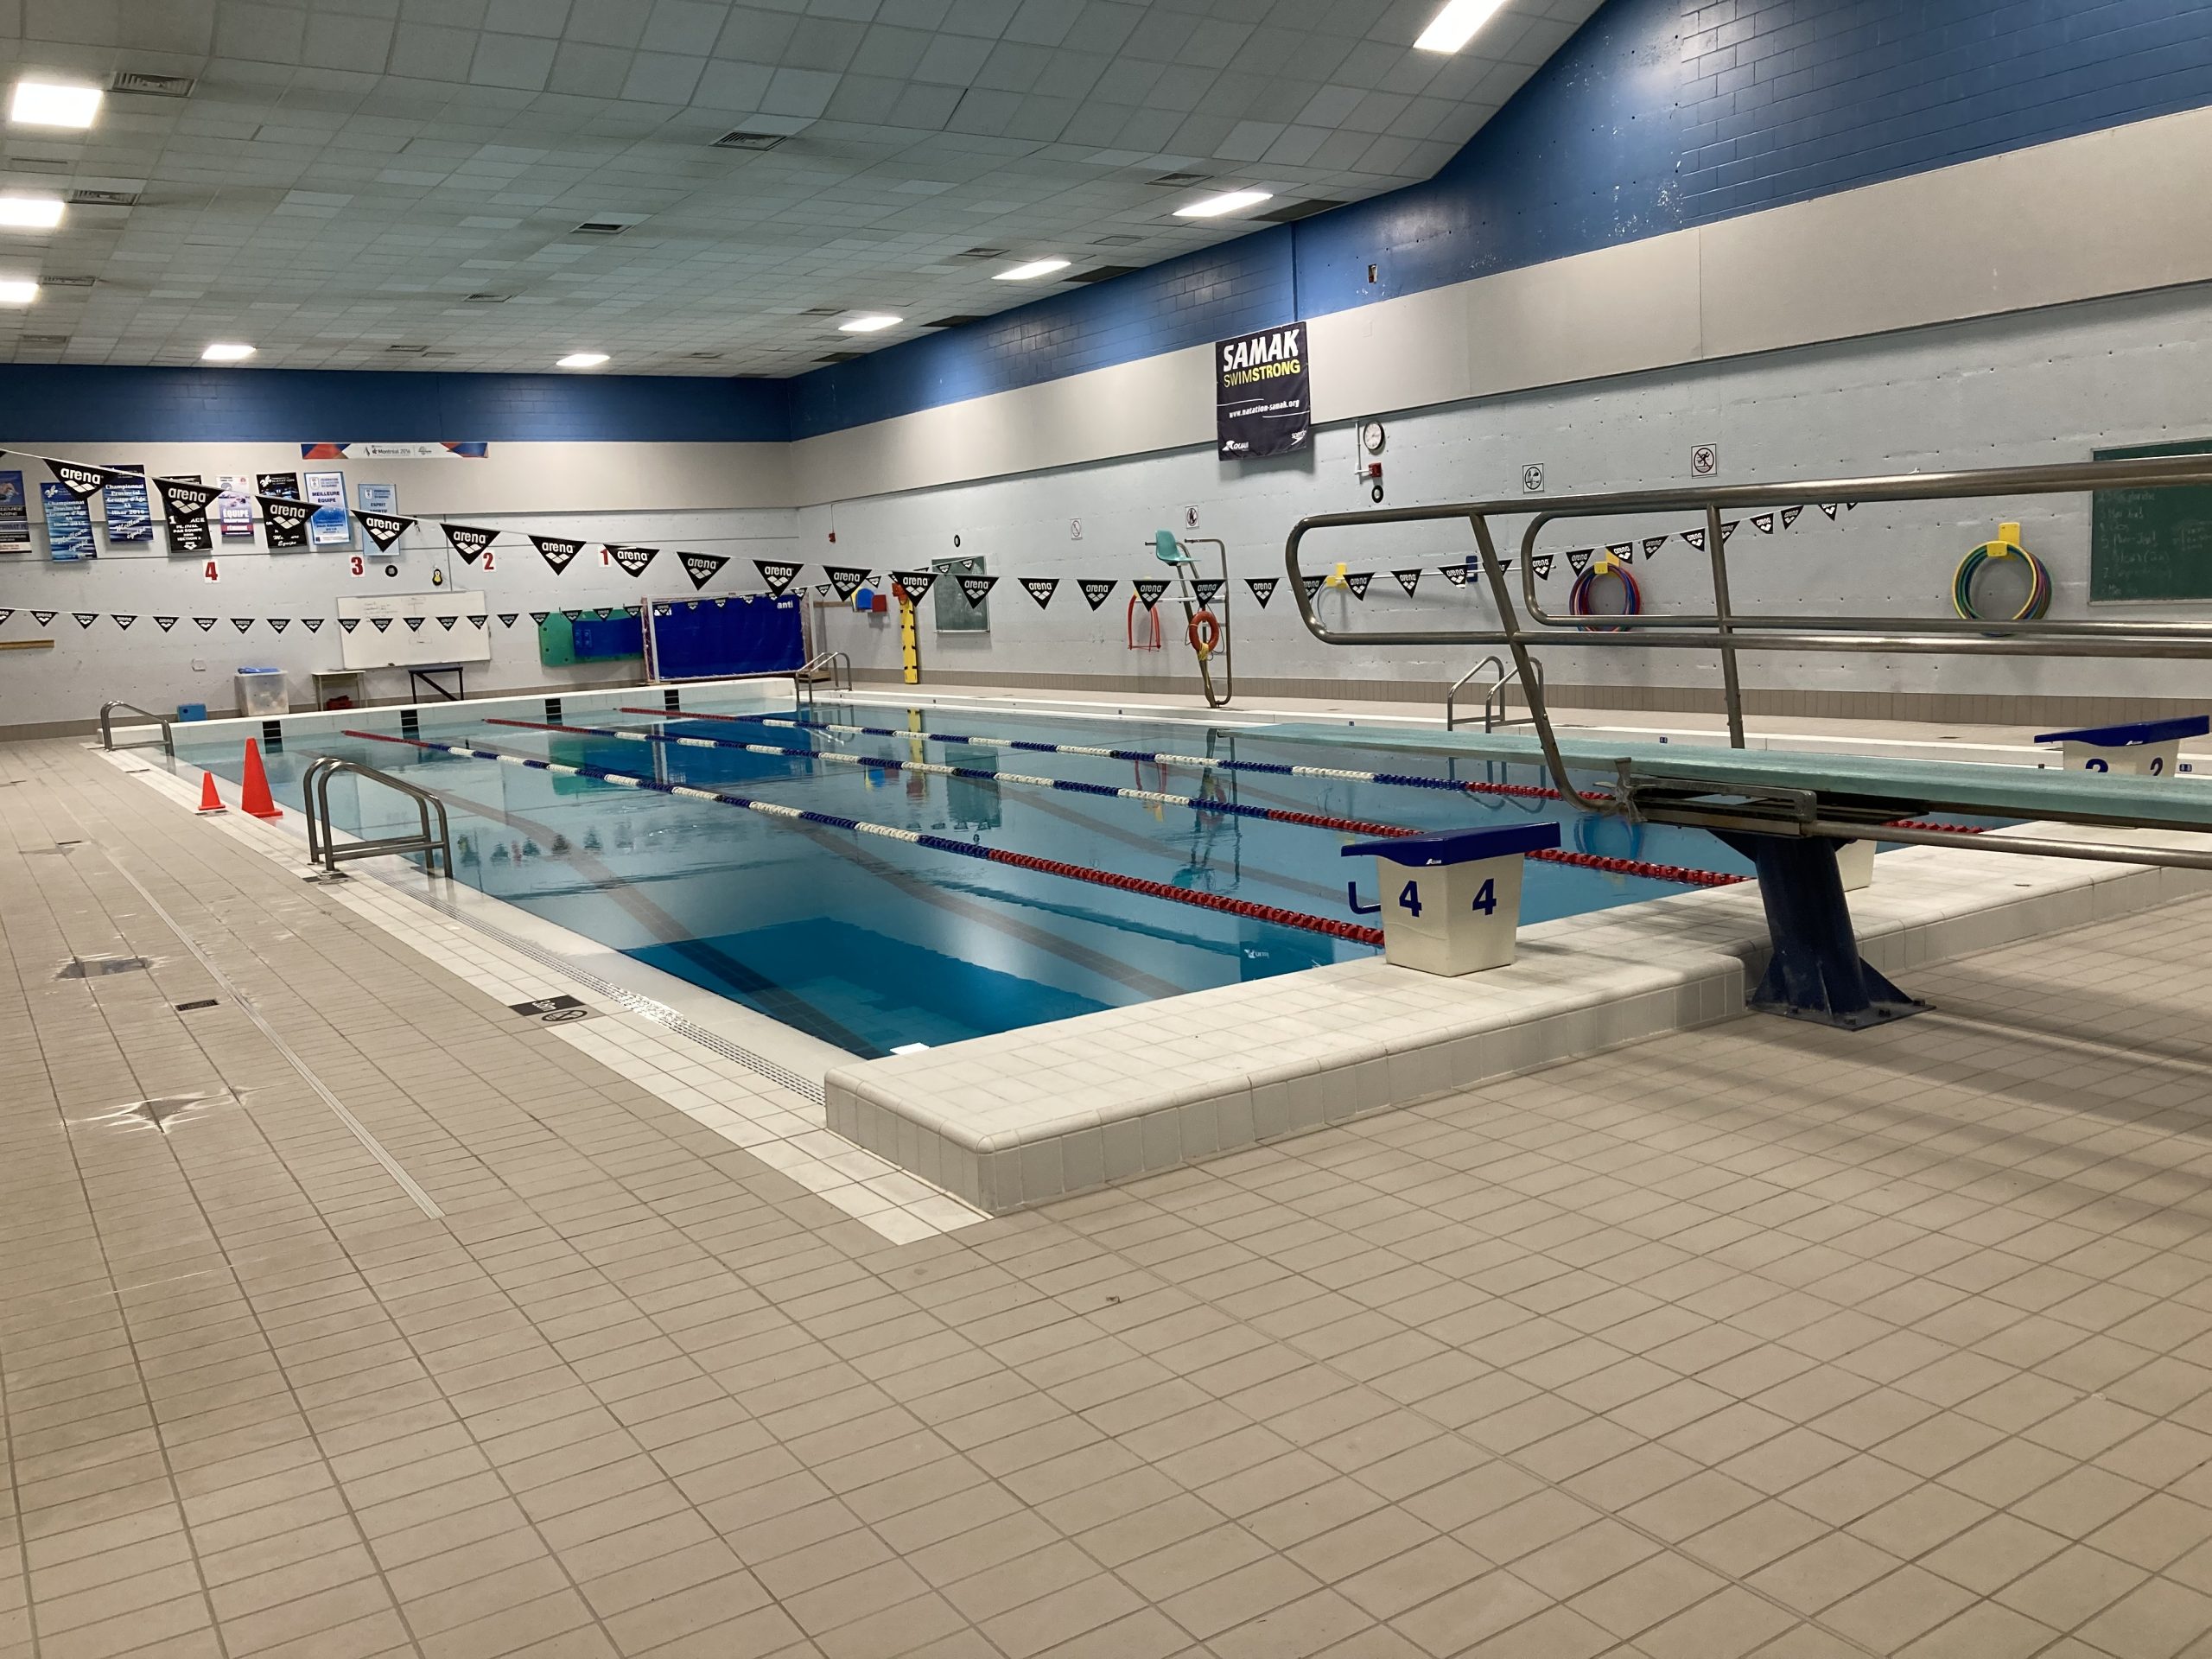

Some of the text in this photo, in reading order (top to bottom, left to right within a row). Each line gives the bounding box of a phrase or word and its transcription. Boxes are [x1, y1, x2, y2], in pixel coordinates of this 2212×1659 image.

[1224, 329, 1300, 372] SAMAK
[1224, 359, 1300, 388] SWIMSTRONG
[1229, 400, 1300, 418] www.natation-samak.org
[60, 467, 101, 485] arena
[168, 487, 207, 503] arena
[270, 504, 306, 518] arena
[366, 518, 400, 531] arena
[453, 531, 486, 544] arena
[541, 541, 574, 554] arena
[483, 552, 495, 570] 2
[600, 549, 609, 566] 1
[617, 550, 647, 561] arena
[351, 556, 364, 576] 3
[687, 557, 717, 569] arena
[205, 562, 219, 581] 4
[765, 565, 792, 576] arena
[834, 571, 861, 582] arena
[1446, 568, 1465, 576] arena
[902, 575, 928, 586] arena
[963, 580, 989, 590] arena
[1028, 582, 1052, 592] arena
[1086, 584, 1109, 593] arena
[1140, 584, 1162, 593] arena
[1197, 583, 1217, 592] arena
[777, 600, 793, 609] anti
[1399, 880, 1422, 918] 4
[1472, 878, 1497, 916] 4
